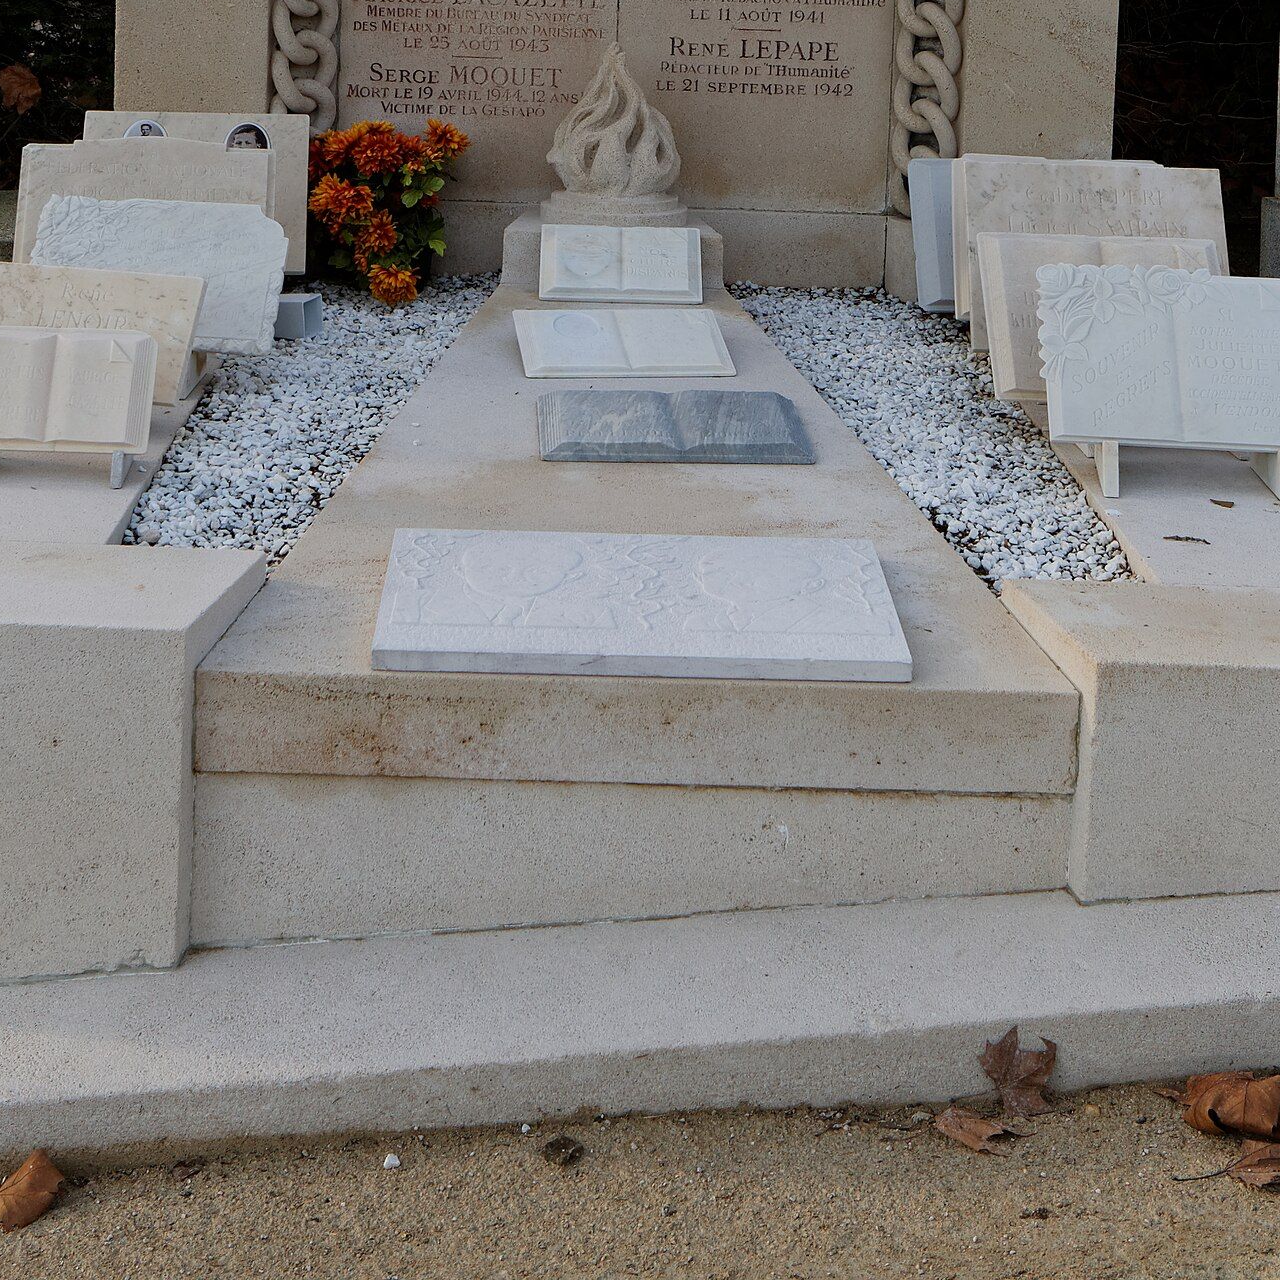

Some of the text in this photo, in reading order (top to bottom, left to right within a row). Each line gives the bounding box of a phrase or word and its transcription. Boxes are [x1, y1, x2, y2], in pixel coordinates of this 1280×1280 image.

[669, 36, 840, 62] RENÉ LEPAPE
[370, 62, 562, 89] SERGE MOQUET
[656, 78, 854, 97] LE 21 SEPTEMBRE 1942
[381, 101, 546, 118] VICTIME DE LA GESTAPO
[1072, 321, 1160, 395] SOUVENIR
[1091, 360, 1171, 426] REGRETS
